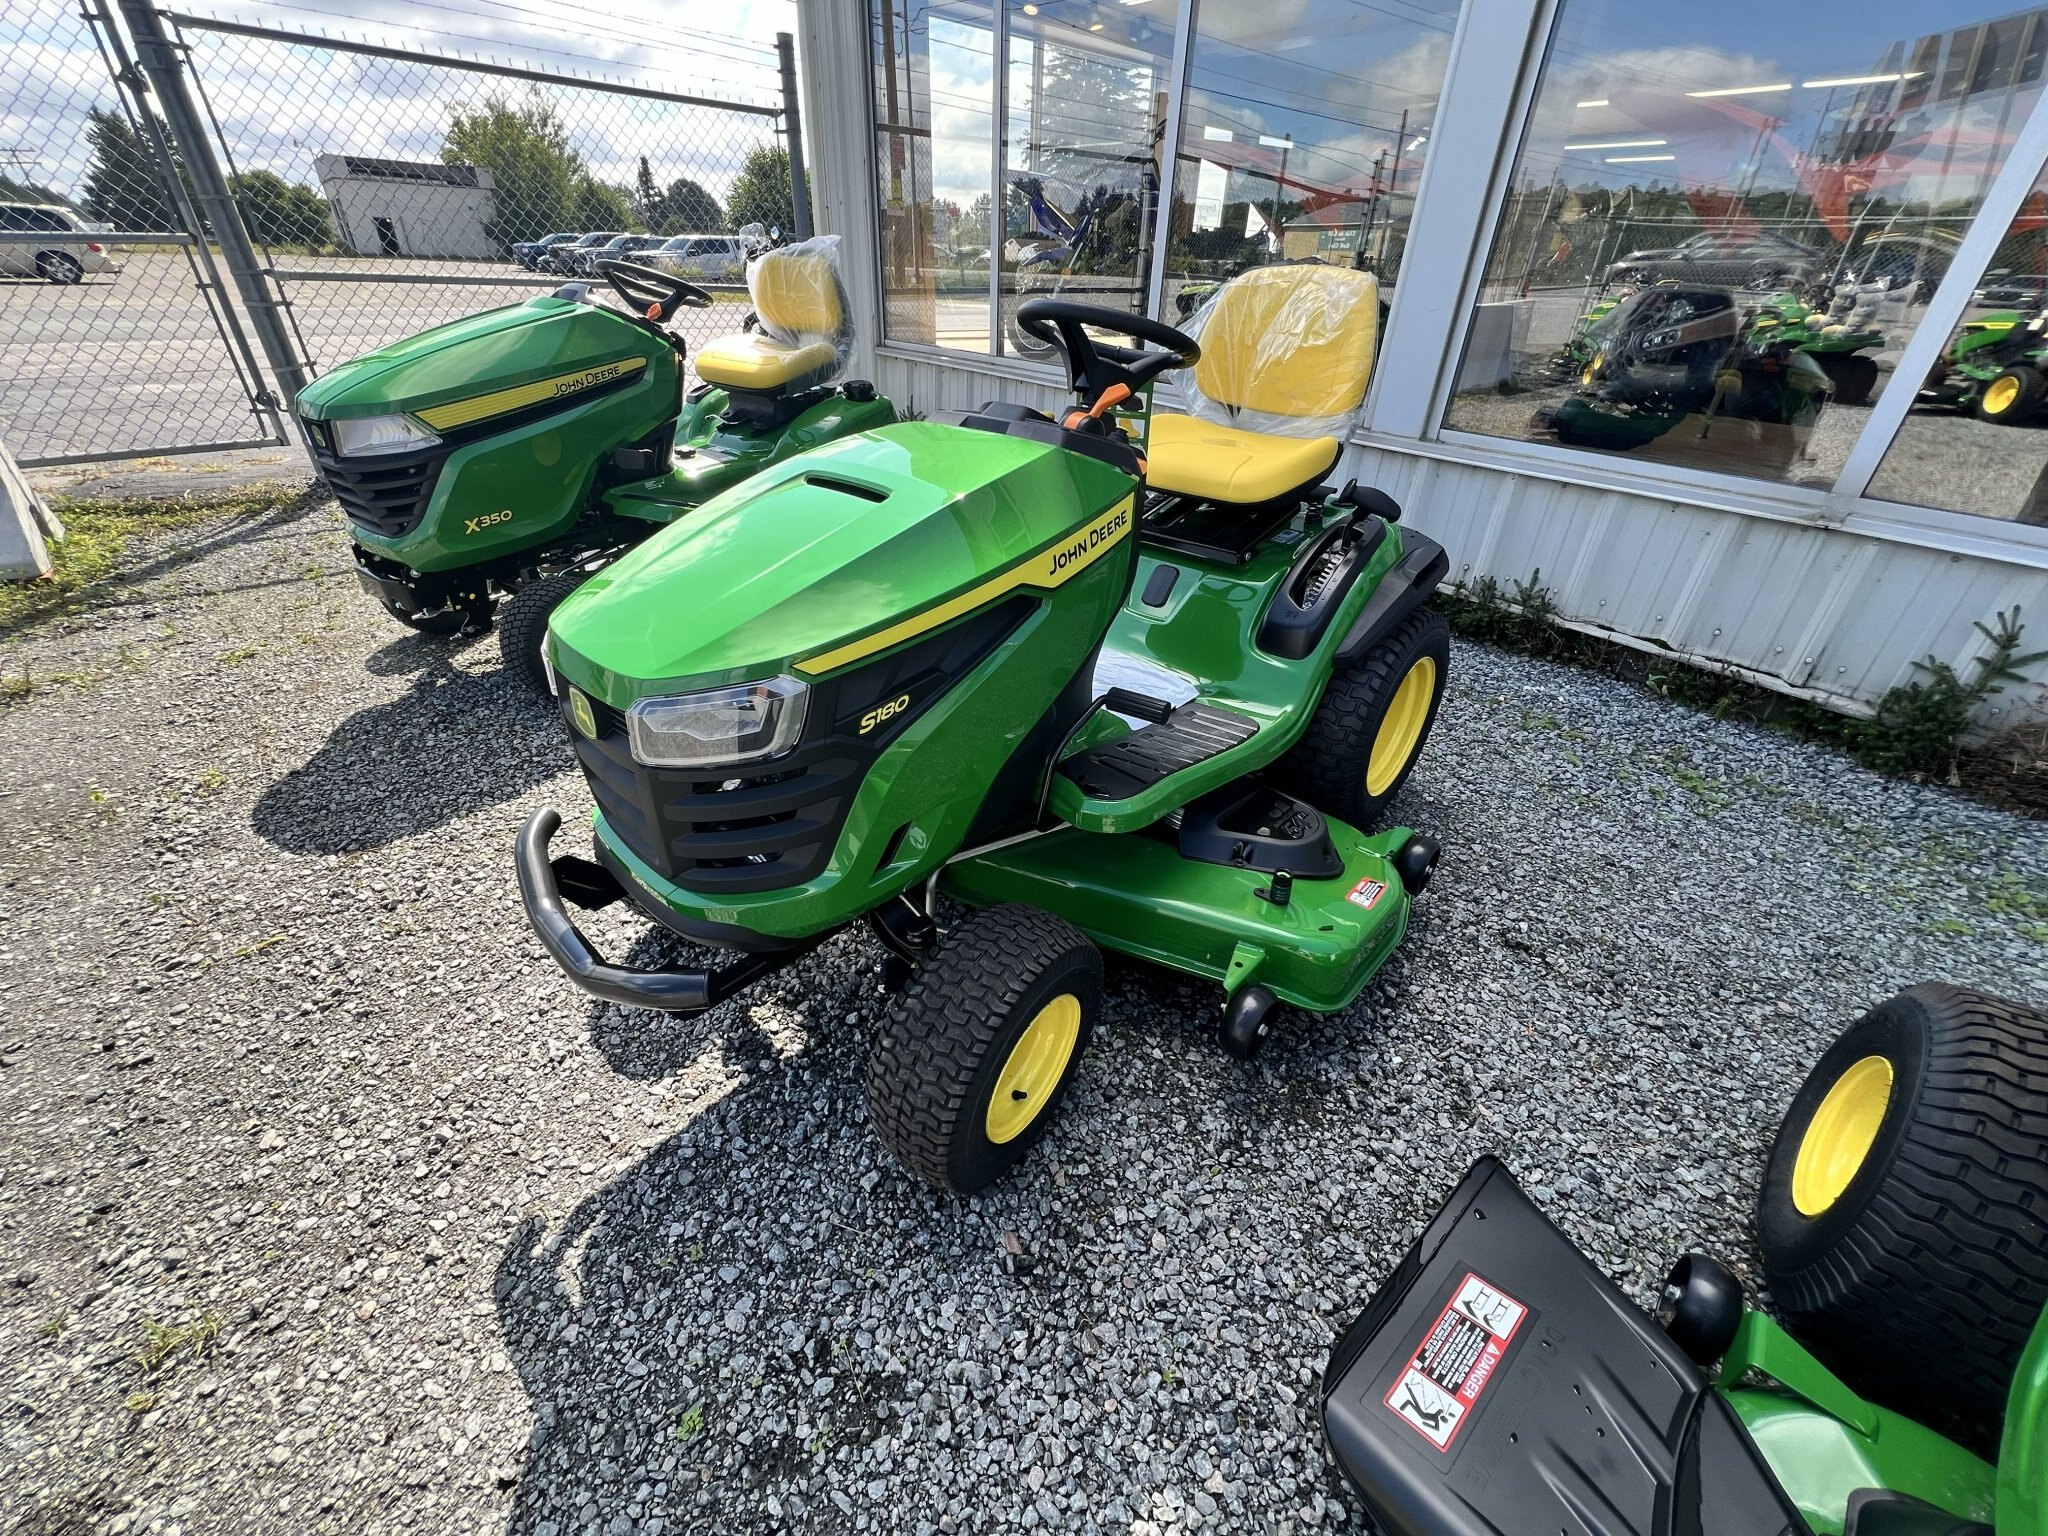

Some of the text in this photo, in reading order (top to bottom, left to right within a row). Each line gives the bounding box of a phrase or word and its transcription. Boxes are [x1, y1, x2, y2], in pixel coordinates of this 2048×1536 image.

[554, 365, 621, 396] JOHN DEERE
[463, 509, 513, 535] X350
[1049, 509, 1128, 576] JOHN DEERE
[859, 694, 910, 735] S180
[1455, 1330, 1471, 1352] THROWN
[1467, 1341, 1485, 1367] ROTATING
[1441, 1351, 1458, 1375] OBJECTS
[1456, 1366, 1470, 1384] BLADE
[1460, 1353, 1497, 1399] DANGER
